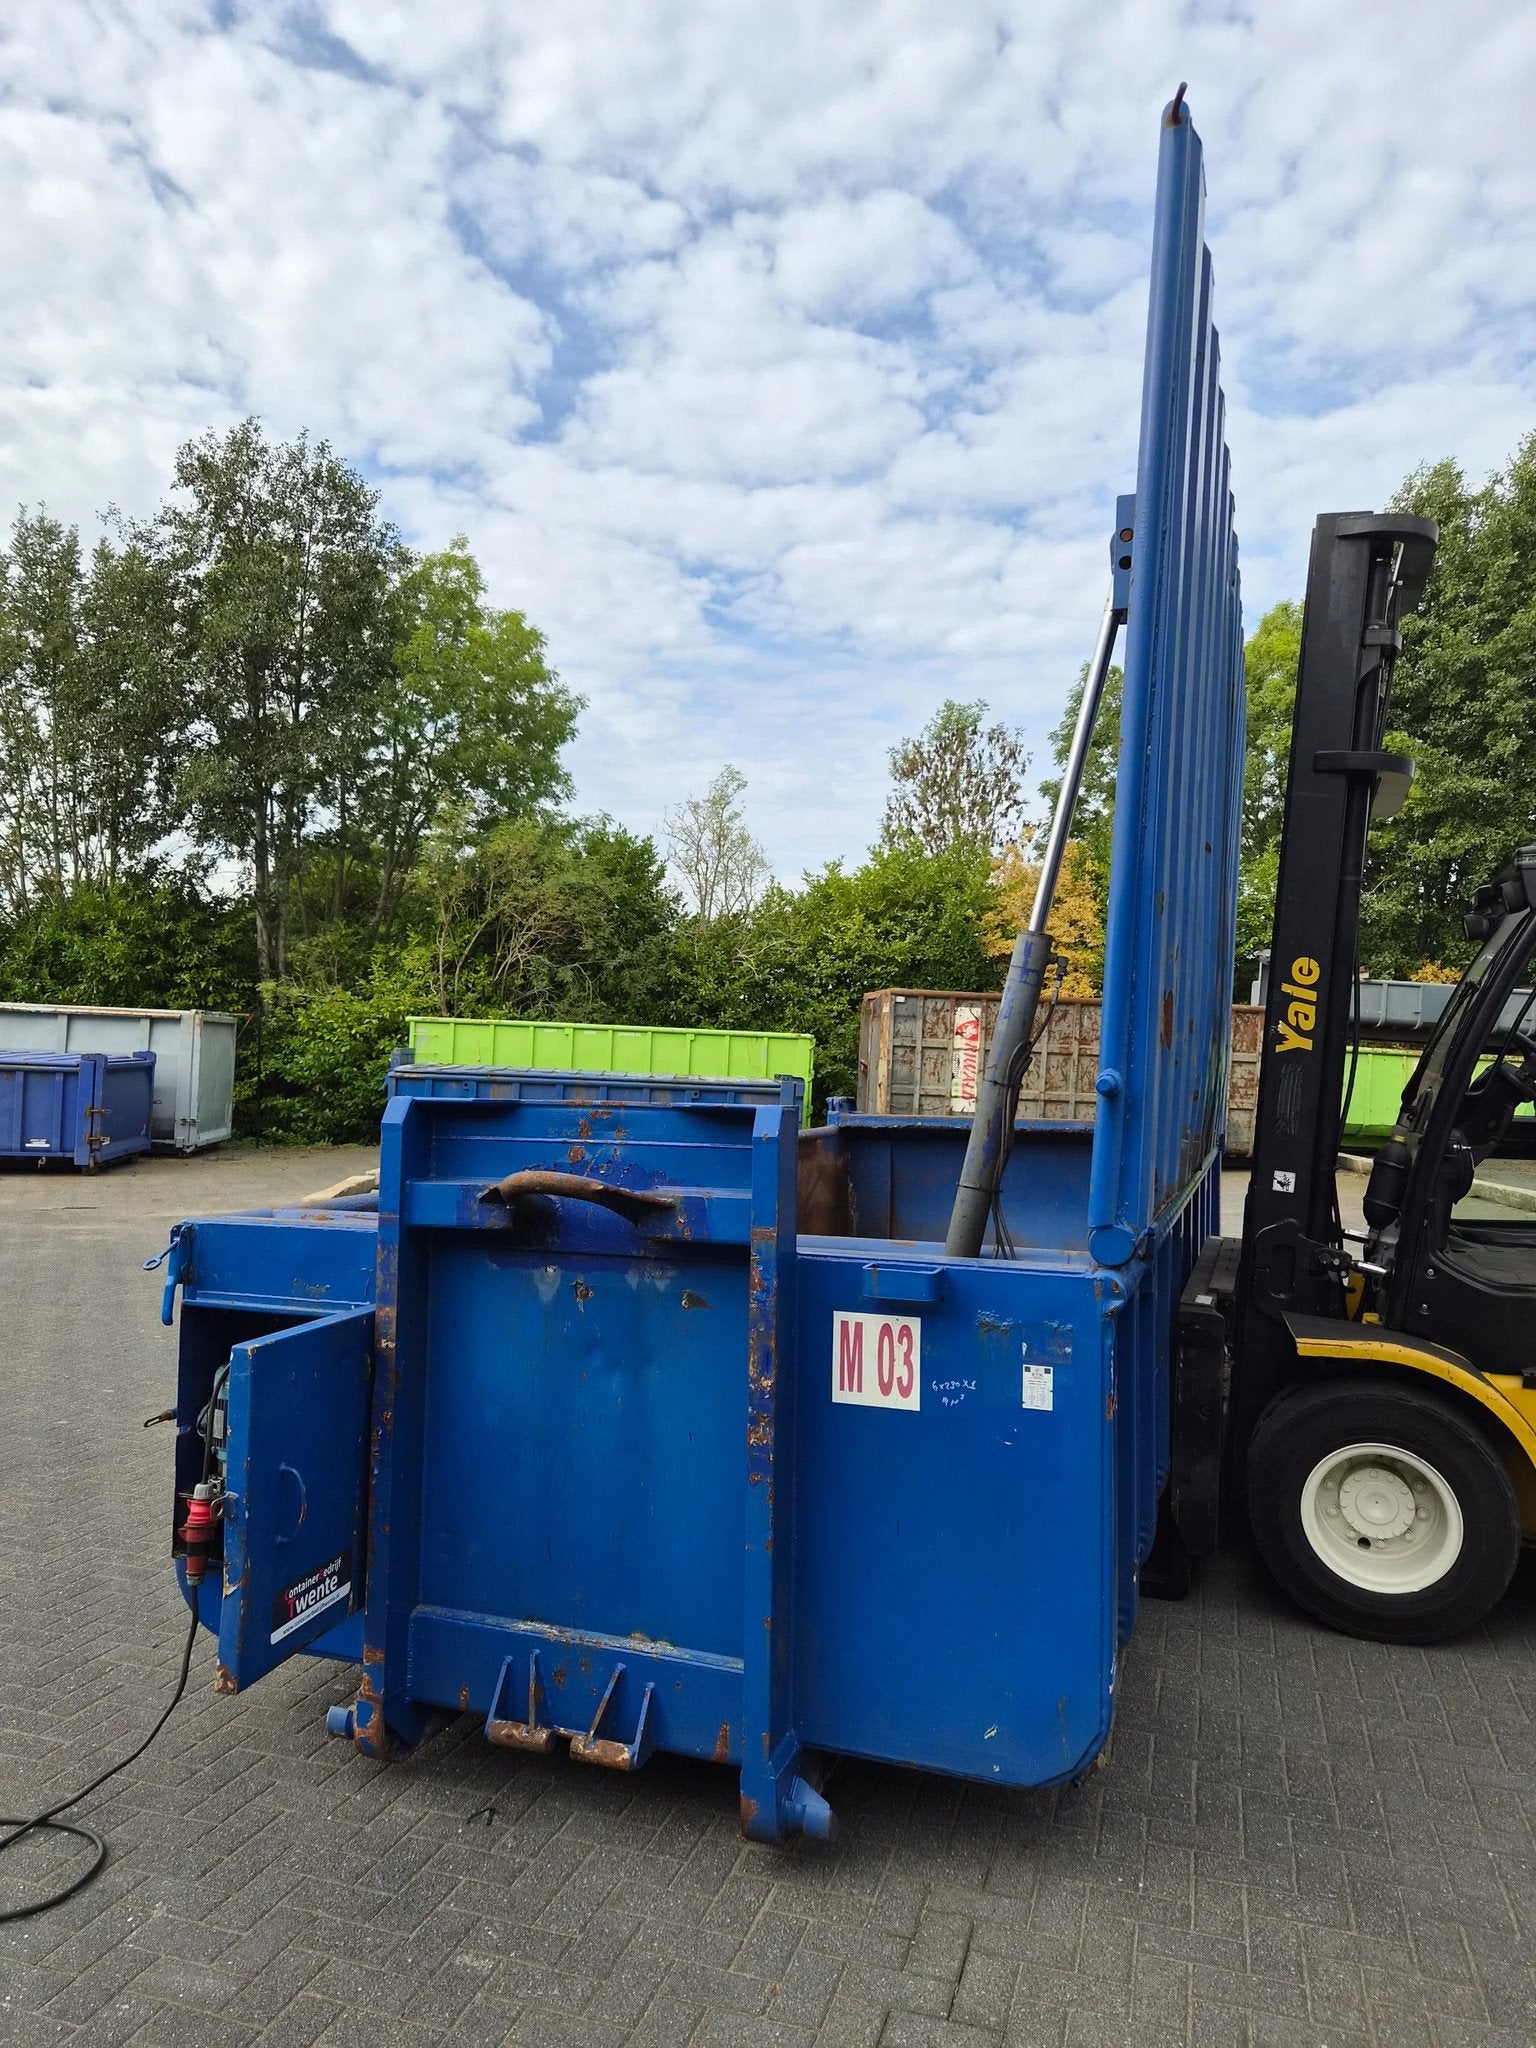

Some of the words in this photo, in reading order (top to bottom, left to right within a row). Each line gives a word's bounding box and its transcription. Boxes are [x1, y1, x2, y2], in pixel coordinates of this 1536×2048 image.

[1275, 956, 1320, 1053] Yale
[961, 1042, 978, 1101] RIWALD
[839, 1320, 863, 1394] M
[877, 1322, 914, 1399] 03
[284, 1556, 342, 1601] ContainerBedrijf
[288, 1575, 338, 1618] Twente
